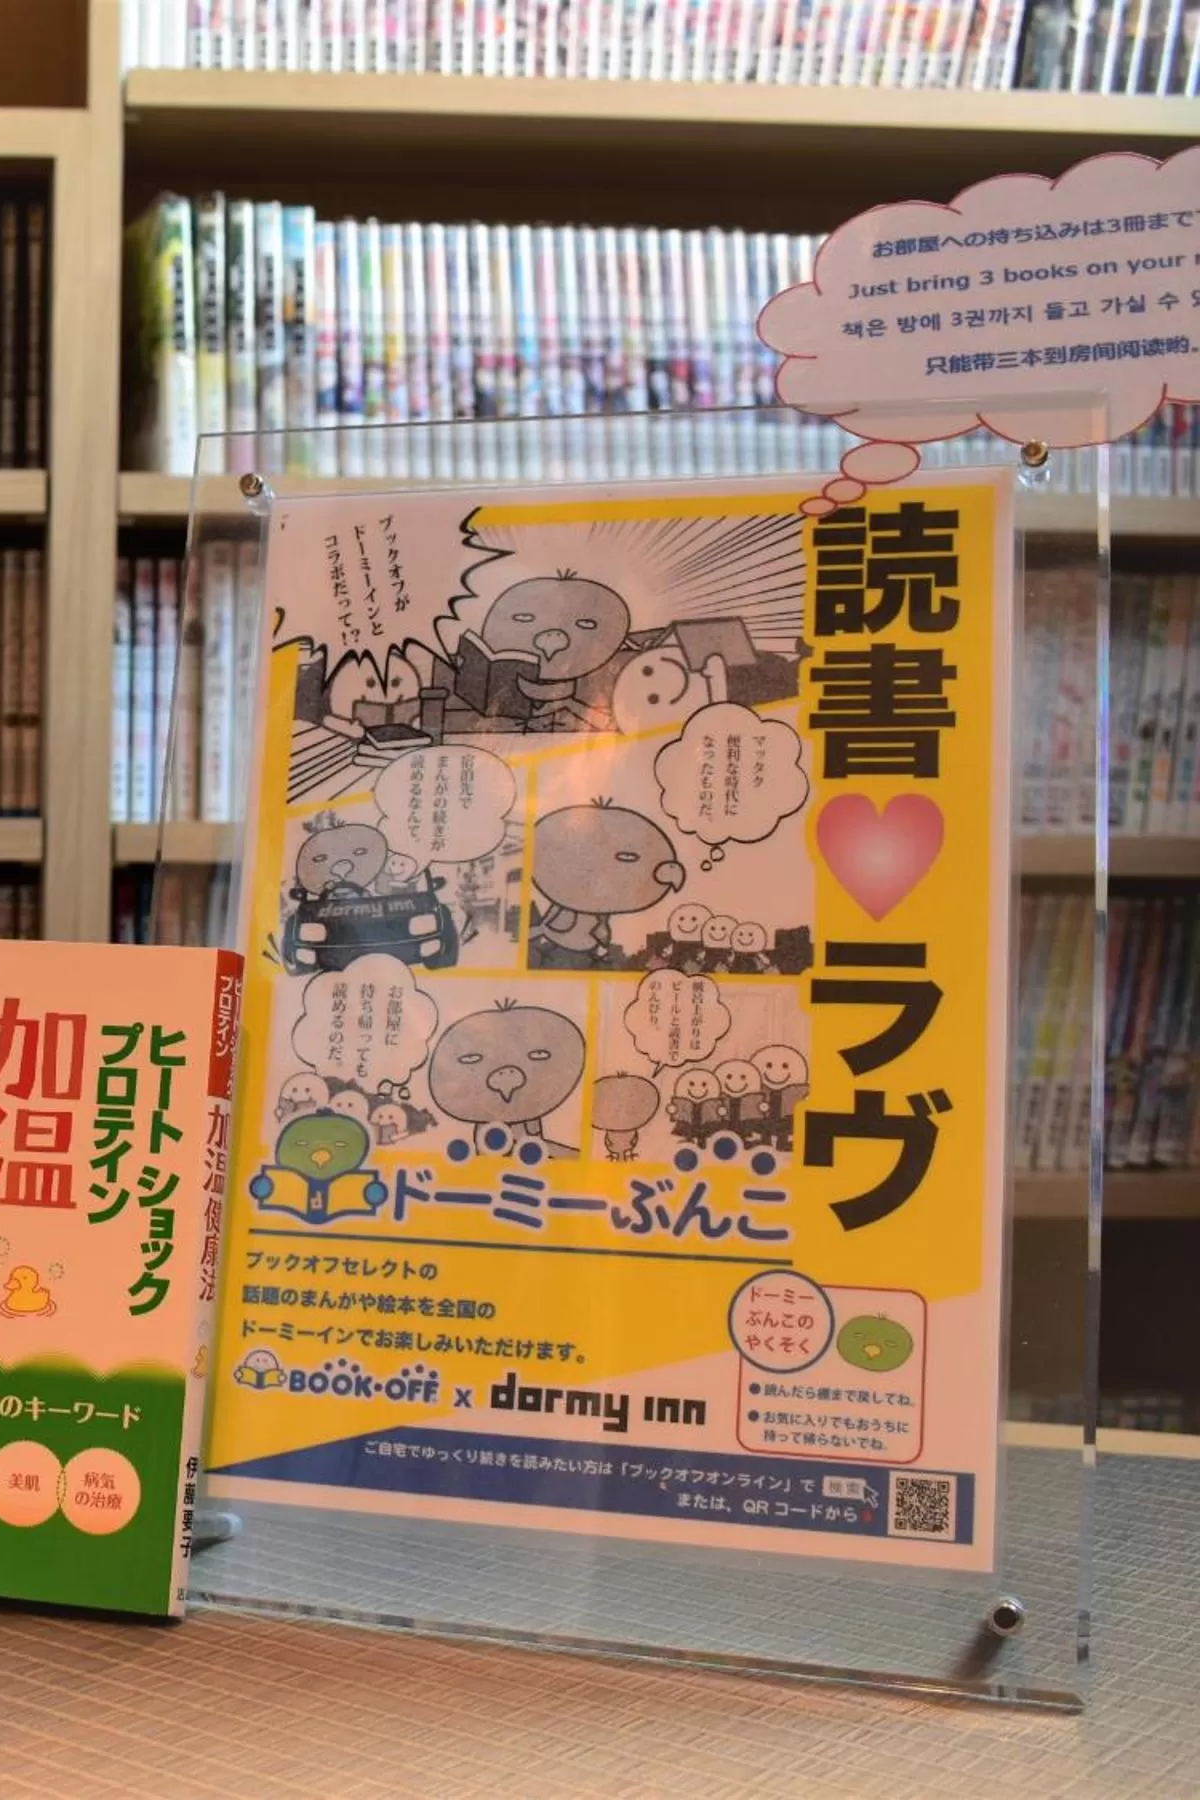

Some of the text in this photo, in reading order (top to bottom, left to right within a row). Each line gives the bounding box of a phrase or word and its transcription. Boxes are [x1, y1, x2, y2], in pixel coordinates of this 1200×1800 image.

[872, 208, 1200, 259] お部屋への持ち込みは3冊まで
[848, 282, 898, 300] Just
[907, 272, 971, 296] bring
[979, 269, 994, 286] 3
[1003, 261, 1078, 284] books
[1086, 260, 1118, 276] on
[1127, 255, 1187, 275] your
[842, 318, 886, 338] 책은
[897, 312, 941, 333] 방에
[950, 302, 1033, 329] 3권까지
[1044, 298, 1091, 321] 들고
[1100, 293, 1145, 315] 가실
[1158, 292, 1180, 311] 수
[354, 525, 384, 637] ドーミーインと
[379, 514, 411, 613] ブックオフが
[803, 502, 960, 1232] 読書 ラヴ
[86, 1022, 145, 1224] プロテイン
[127, 1025, 187, 1316] ヒートショック
[392, 1168, 789, 1241] ドーミーぶんこ
[246, 1251, 438, 1281] ブックオフセレクトの
[242, 1285, 496, 1321] 話題のまんがや絵本を全国の
[749, 1286, 815, 1304] ドーミー
[240, 1320, 587, 1364] ドーミーインでお楽しみいただけます。
[745, 1312, 814, 1330] ぶんこの
[745, 1336, 810, 1354] やくそく
[490, 1372, 629, 1433] dormy
[644, 1393, 706, 1426] inn
[763, 1412, 909, 1434] お気に入りでもおうちに
[8, 1472, 40, 1493] 美肌
[75, 1490, 123, 1512] の治療
[83, 1471, 116, 1490] 病気
